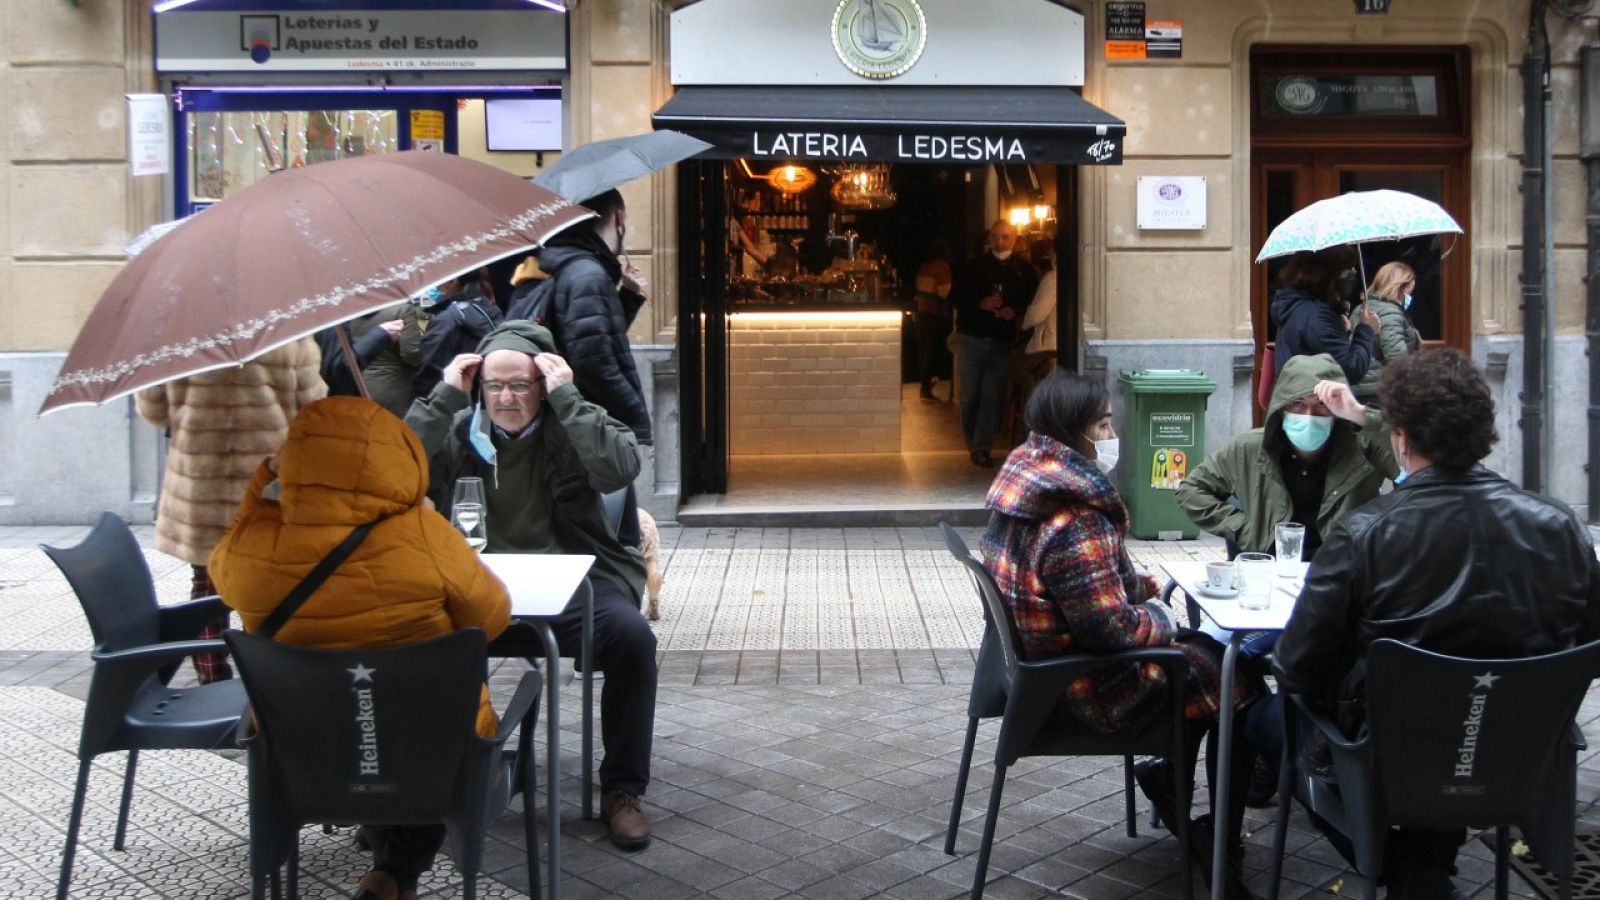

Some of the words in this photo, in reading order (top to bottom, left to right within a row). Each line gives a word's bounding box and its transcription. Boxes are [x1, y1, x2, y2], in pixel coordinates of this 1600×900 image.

[368, 18, 379, 33] y
[285, 37, 373, 53] Apuestas
[379, 36, 408, 50] del
[414, 36, 479, 50] Estado
[753, 131, 867, 156] LATERIA
[897, 134, 1026, 161] LEDESMA
[1153, 209, 1191, 217] MIGOYA
[356, 688, 379, 775] Heineken
[1454, 694, 1488, 777] Heineken
